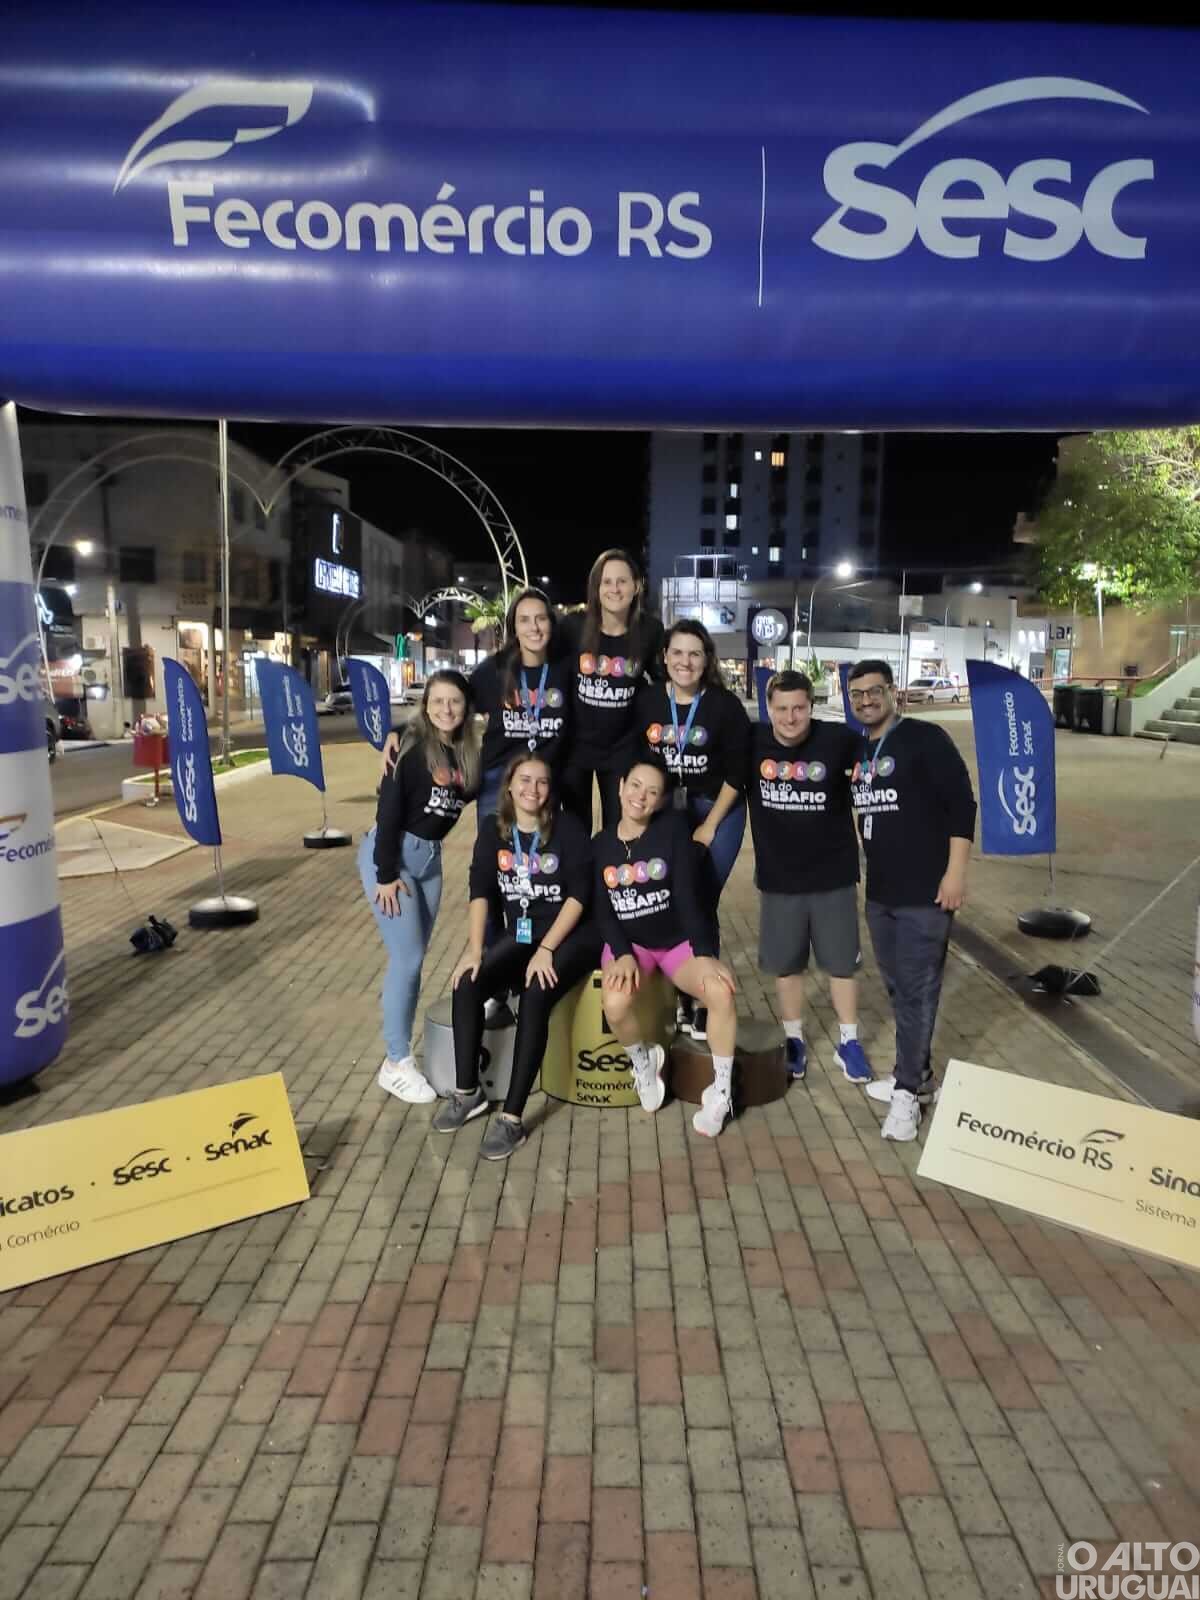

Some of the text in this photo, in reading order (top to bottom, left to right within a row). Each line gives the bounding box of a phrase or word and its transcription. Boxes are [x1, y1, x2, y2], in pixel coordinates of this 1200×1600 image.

[811, 132, 1154, 262] Sesc
[168, 182, 712, 259] Fecomércio RS
[1004, 690, 1019, 757] Fecomércio
[1021, 719, 1034, 756] Senac
[291, 722, 309, 768] Sesc
[184, 752, 198, 824] Sesc
[759, 779, 793, 793] Dia do
[761, 789, 827, 804] DESAFIO
[1013, 766, 1037, 836] Sesc
[577, 1049, 635, 1072] Ses
[575, 1078, 636, 1091] Fecomérc
[576, 1092, 611, 1104] Senac
[113, 1156, 172, 1185] Sesc
[204, 1129, 273, 1161] Senac
[957, 1111, 1076, 1160] Fecomércio
[1082, 1147, 1114, 1171] RS
[7, 1219, 80, 1249] Comércio
[1135, 1199, 1197, 1229] Sistema
